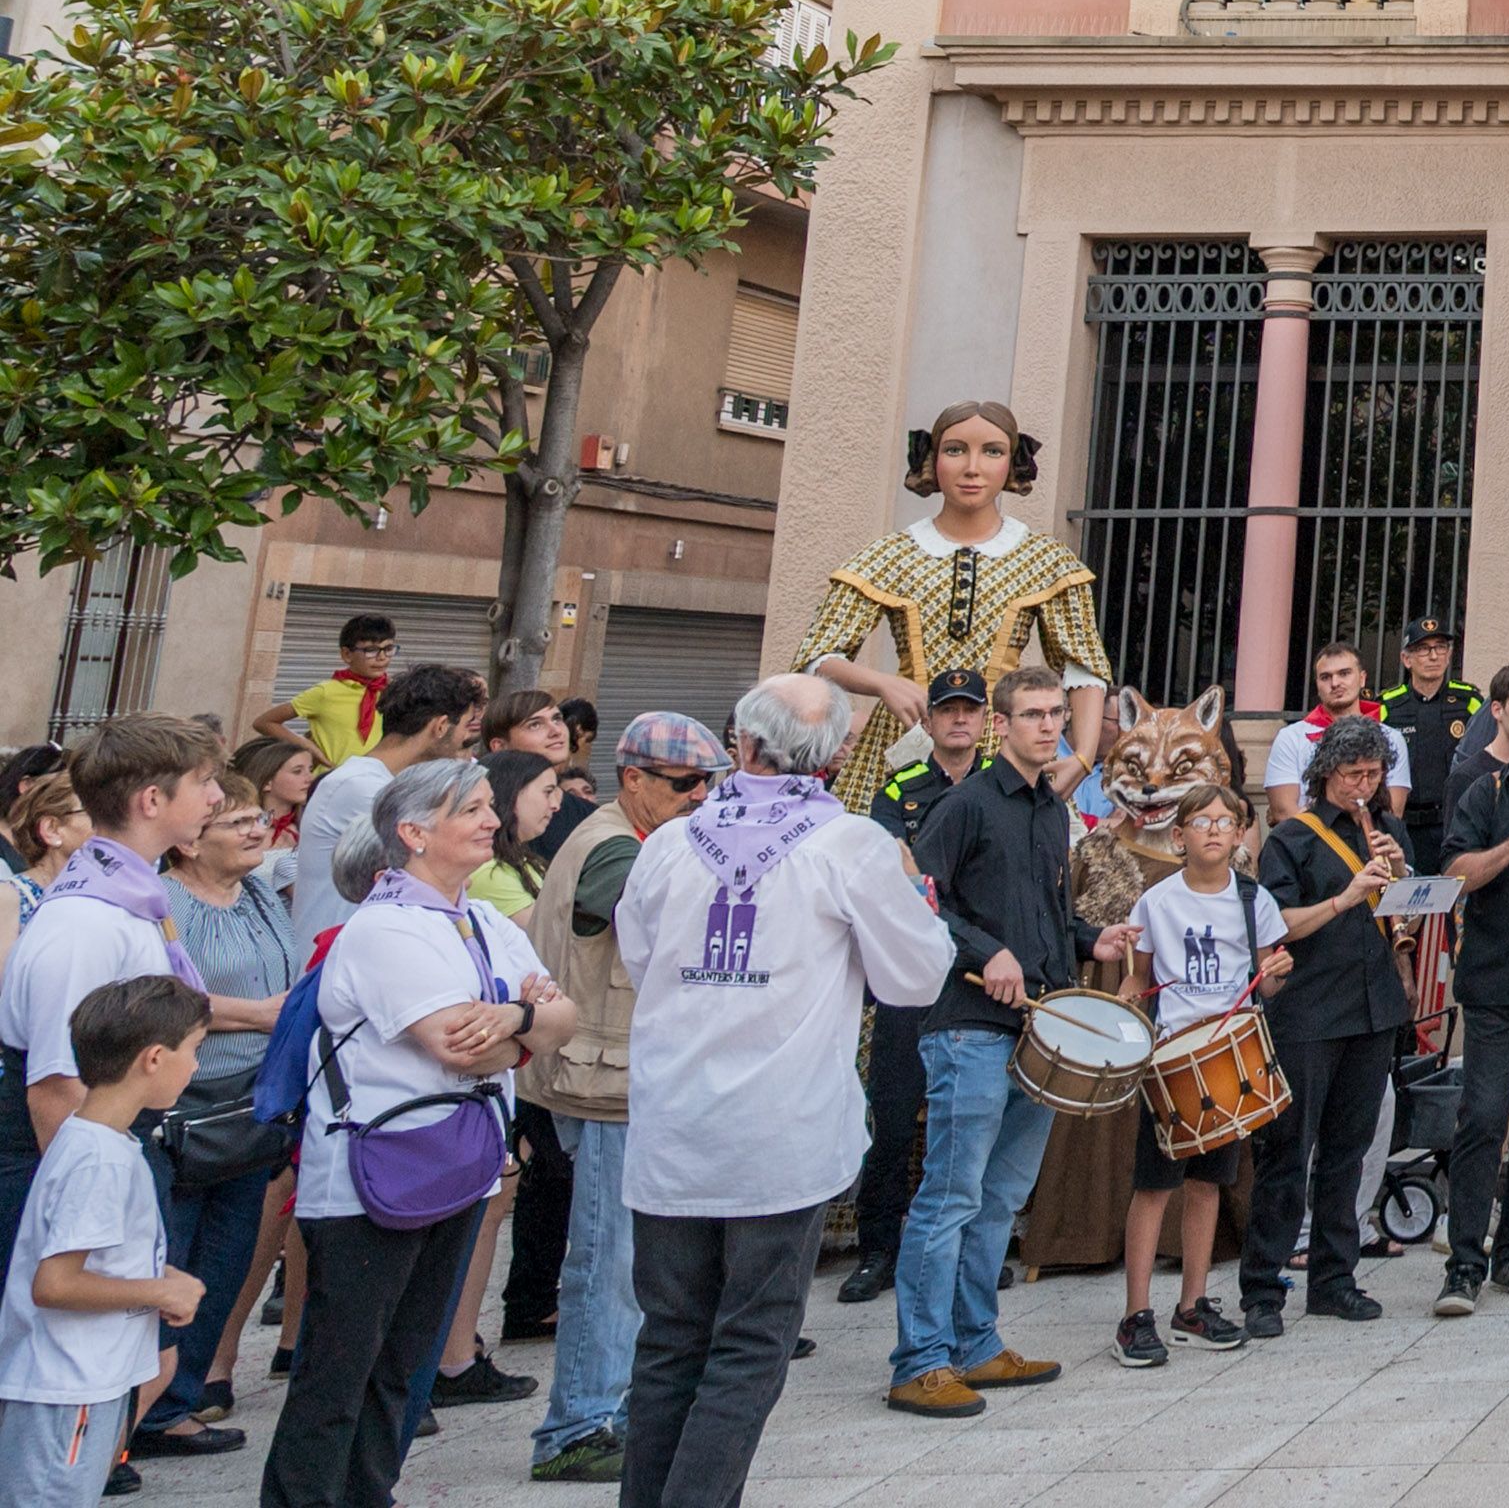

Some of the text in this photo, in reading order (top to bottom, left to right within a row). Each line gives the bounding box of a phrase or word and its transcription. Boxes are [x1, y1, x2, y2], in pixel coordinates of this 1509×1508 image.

[757, 845, 777, 863] DE
[780, 815, 816, 845] RUBÍ
[681, 968, 733, 982] GEGANTERS
